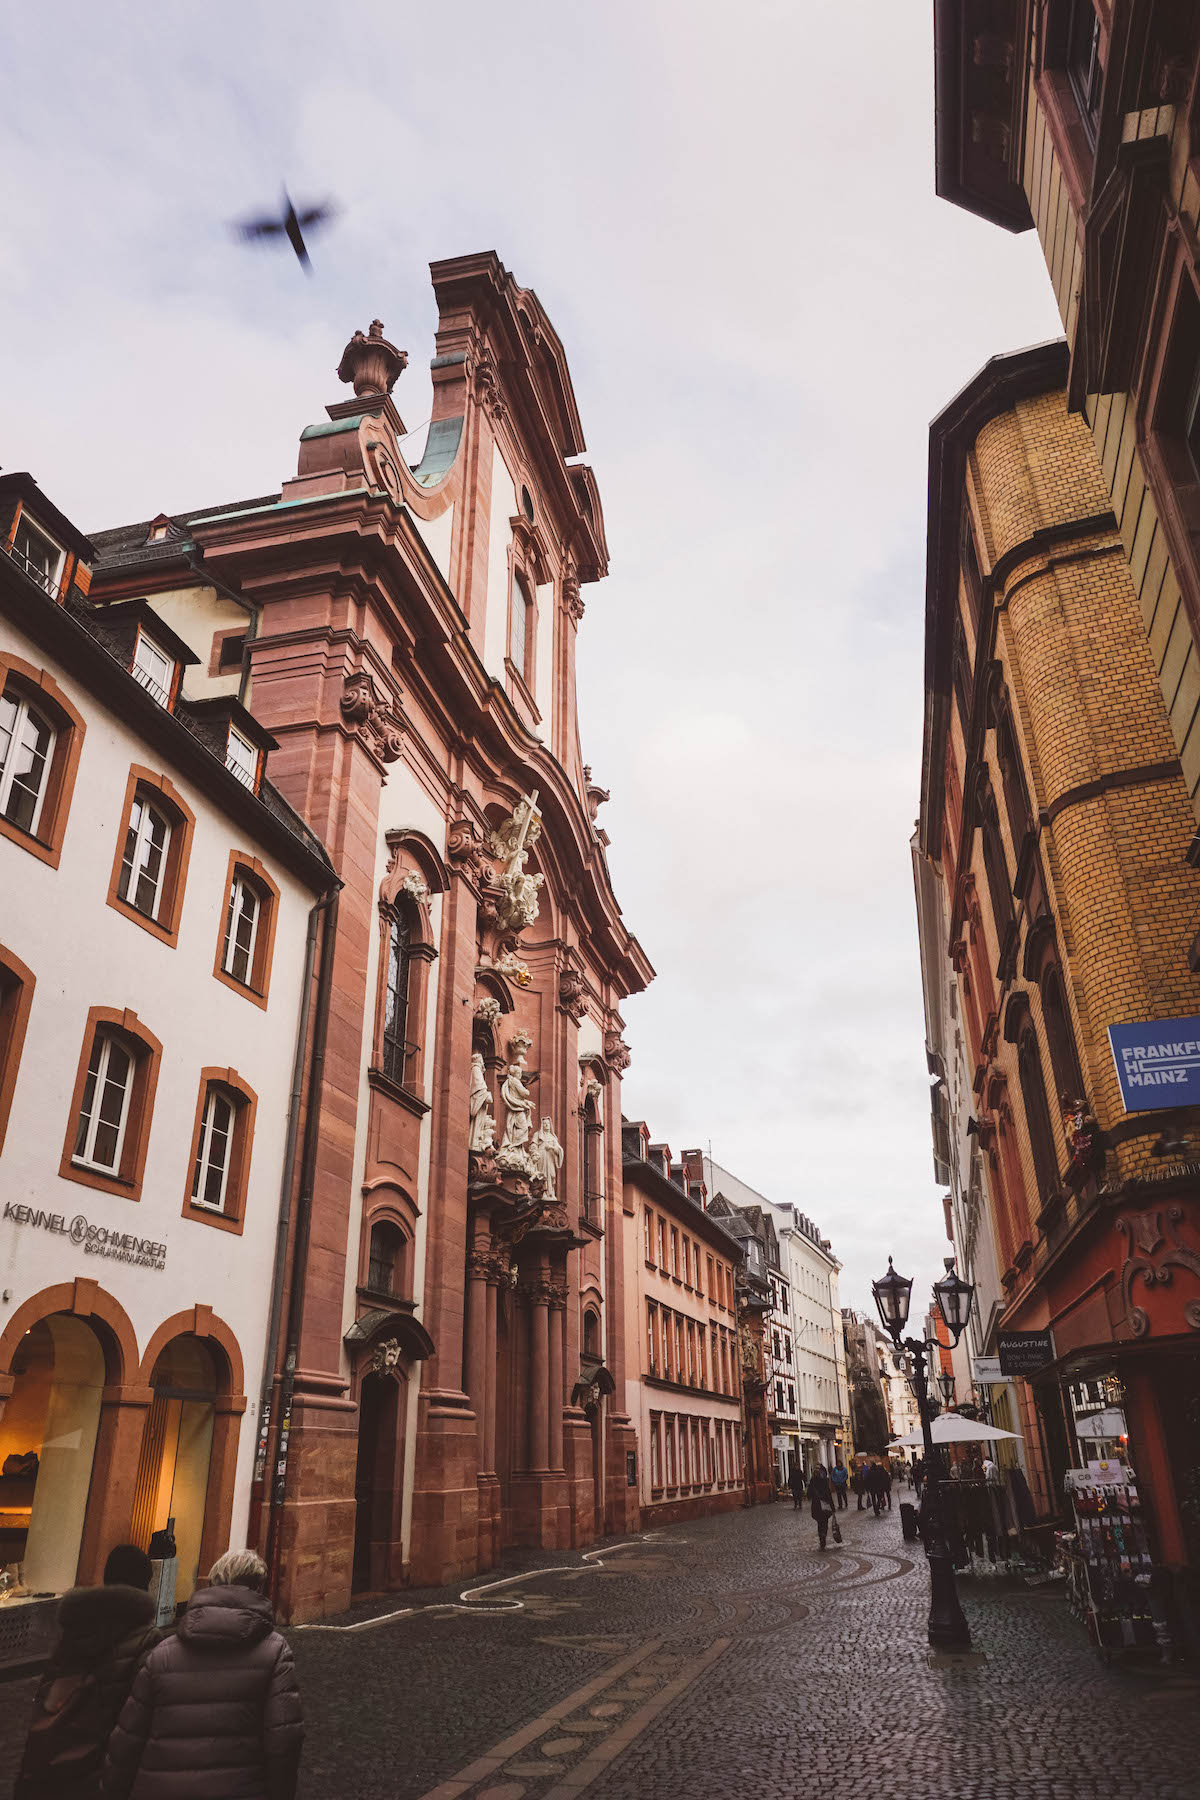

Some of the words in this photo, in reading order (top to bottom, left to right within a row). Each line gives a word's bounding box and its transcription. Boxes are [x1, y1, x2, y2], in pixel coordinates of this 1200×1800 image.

[1127, 1069, 1188, 1087] MAINZ
[3, 1201, 70, 1234] KENNEL
[87, 1225, 167, 1258] SCHMENGER
[84, 1242, 166, 1270] SCHUHMANUFAKTUR
[999, 1340, 1049, 1349] AUGUSTINE
